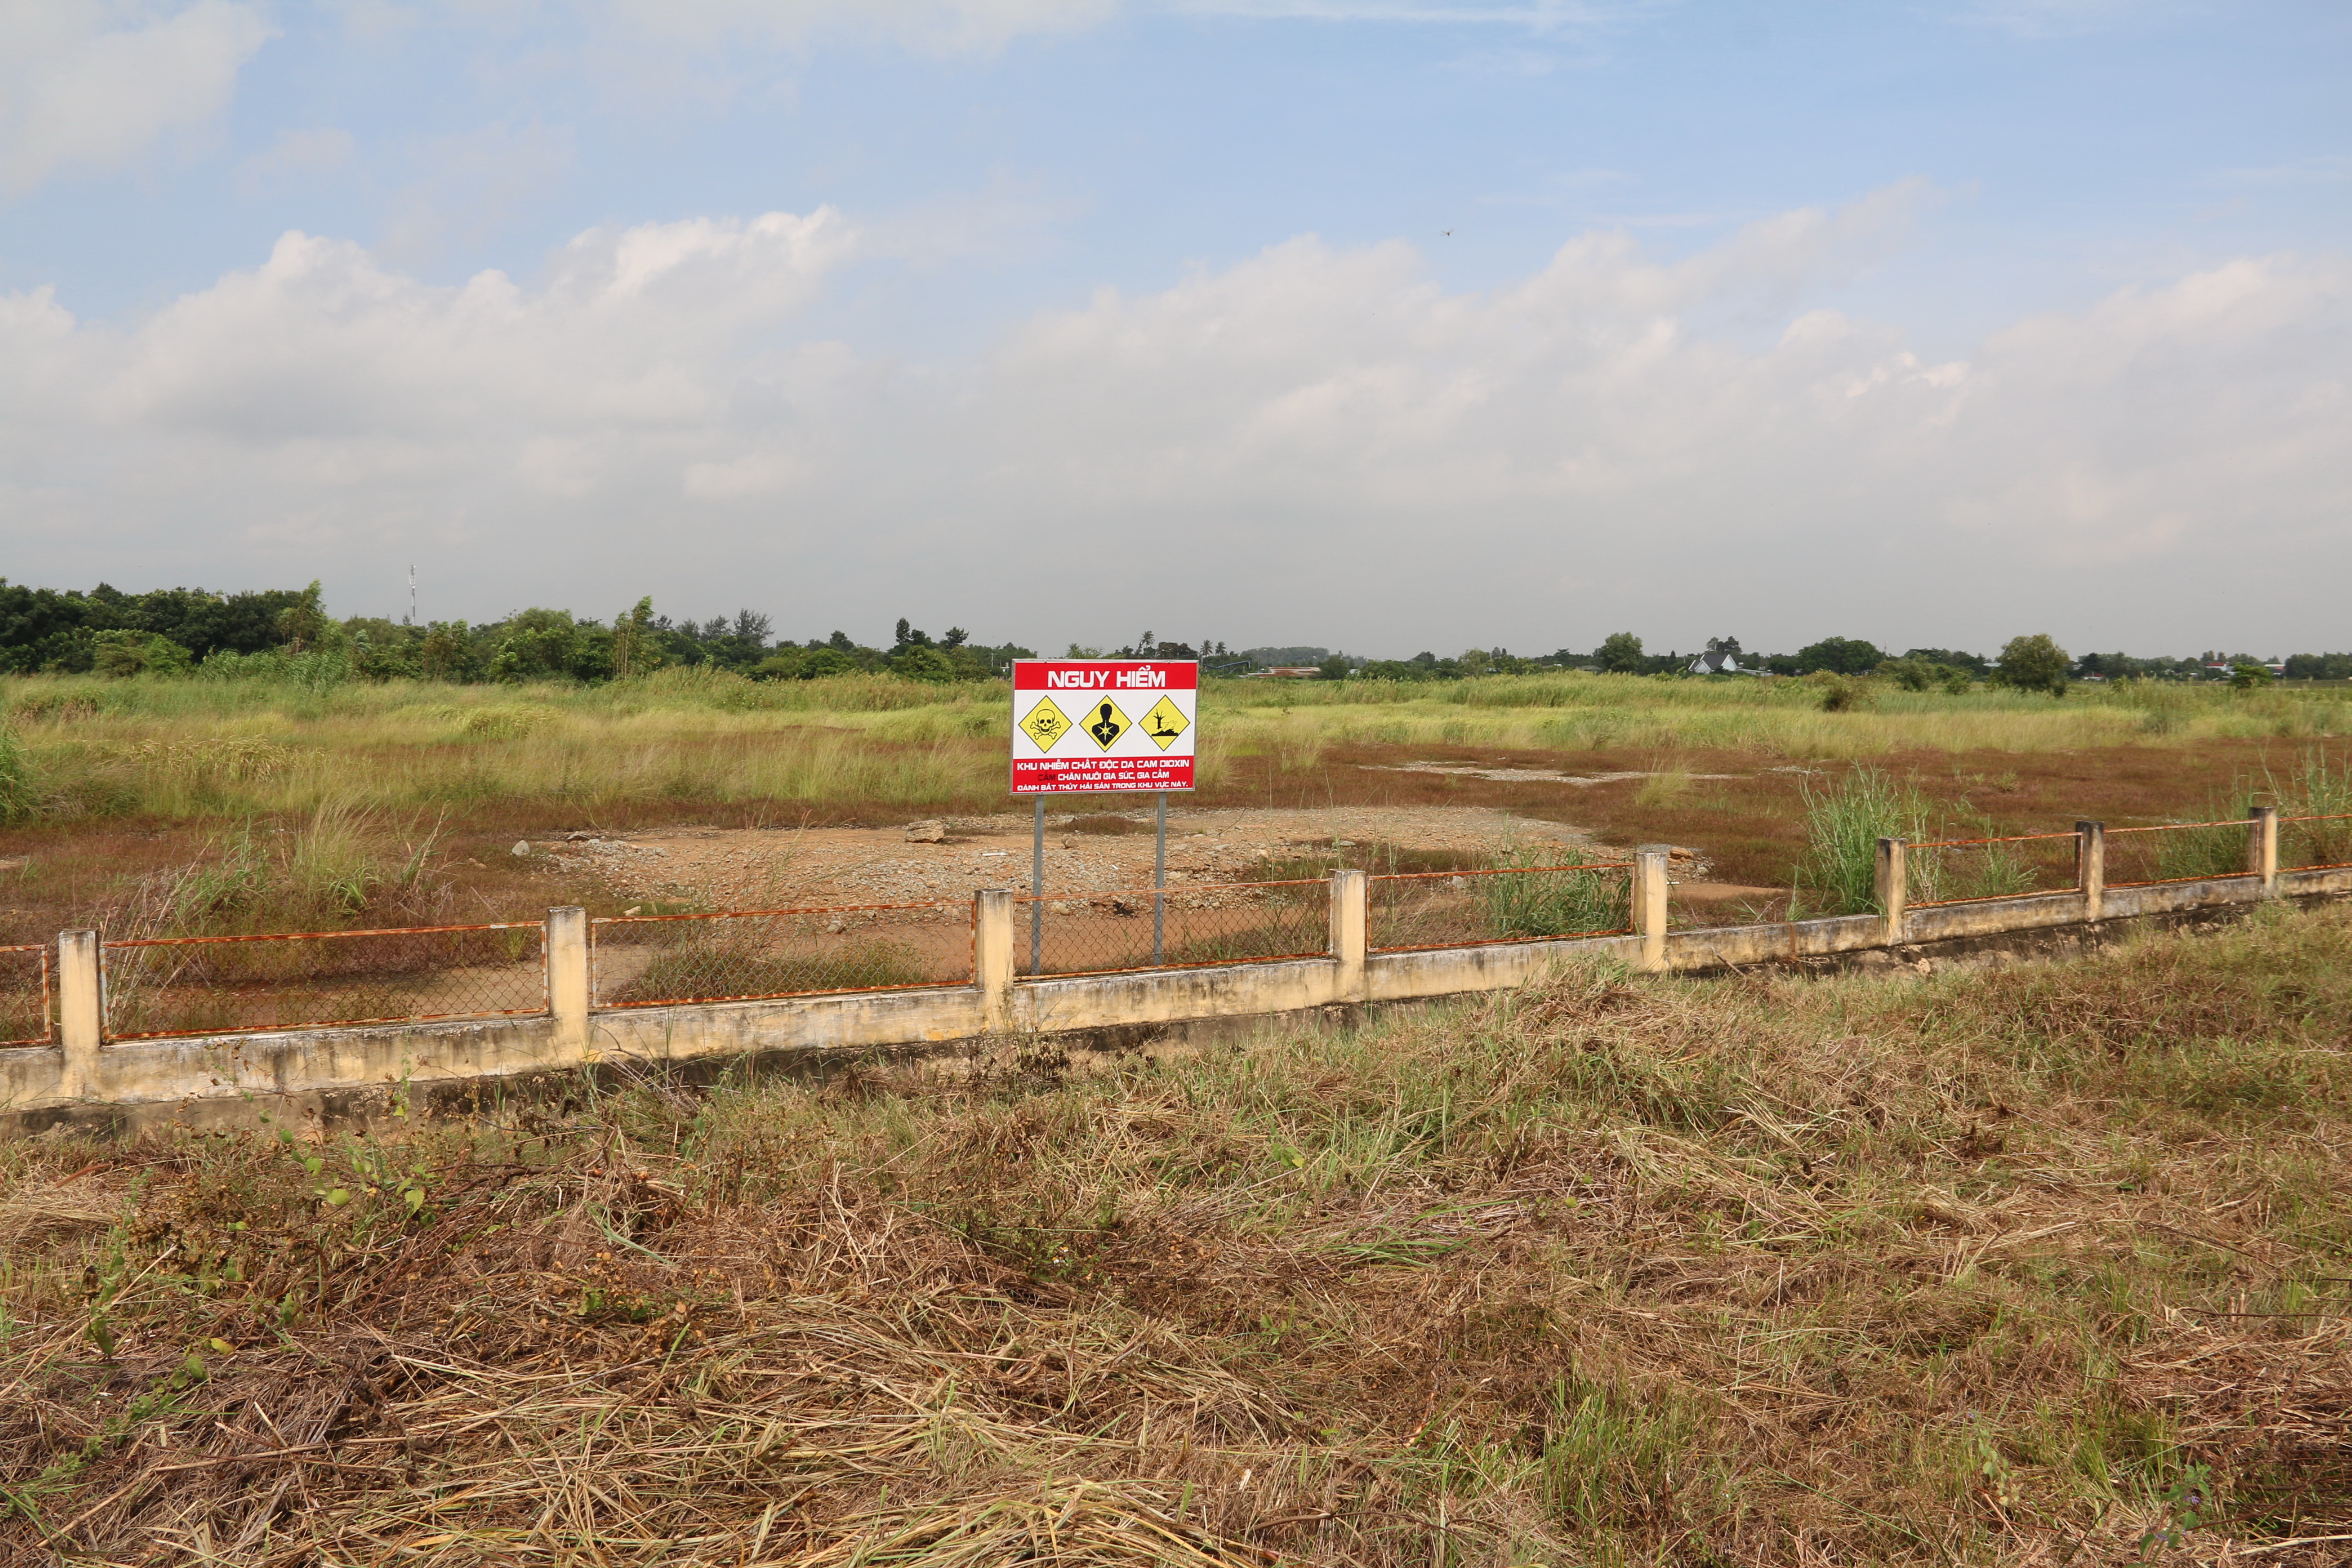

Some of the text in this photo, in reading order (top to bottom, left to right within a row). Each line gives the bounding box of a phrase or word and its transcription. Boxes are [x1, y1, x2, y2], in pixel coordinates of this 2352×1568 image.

[1047, 665, 1166, 688] NGUY HIỂM
[1017, 762, 1037, 770] KHU
[1040, 759, 1069, 770] NHIỄM
[1072, 758, 1097, 769] CHẤT
[1099, 759, 1119, 770] ĐỘC
[1159, 760, 1190, 768] DIOXIN
[1058, 772, 1081, 781] CHĂN
[1083, 771, 1101, 780] NUÔI
[1118, 770, 1135, 780] SÚC,
[1152, 769, 1170, 779] CẦM
[1155, 781, 1170, 789] VỰC
